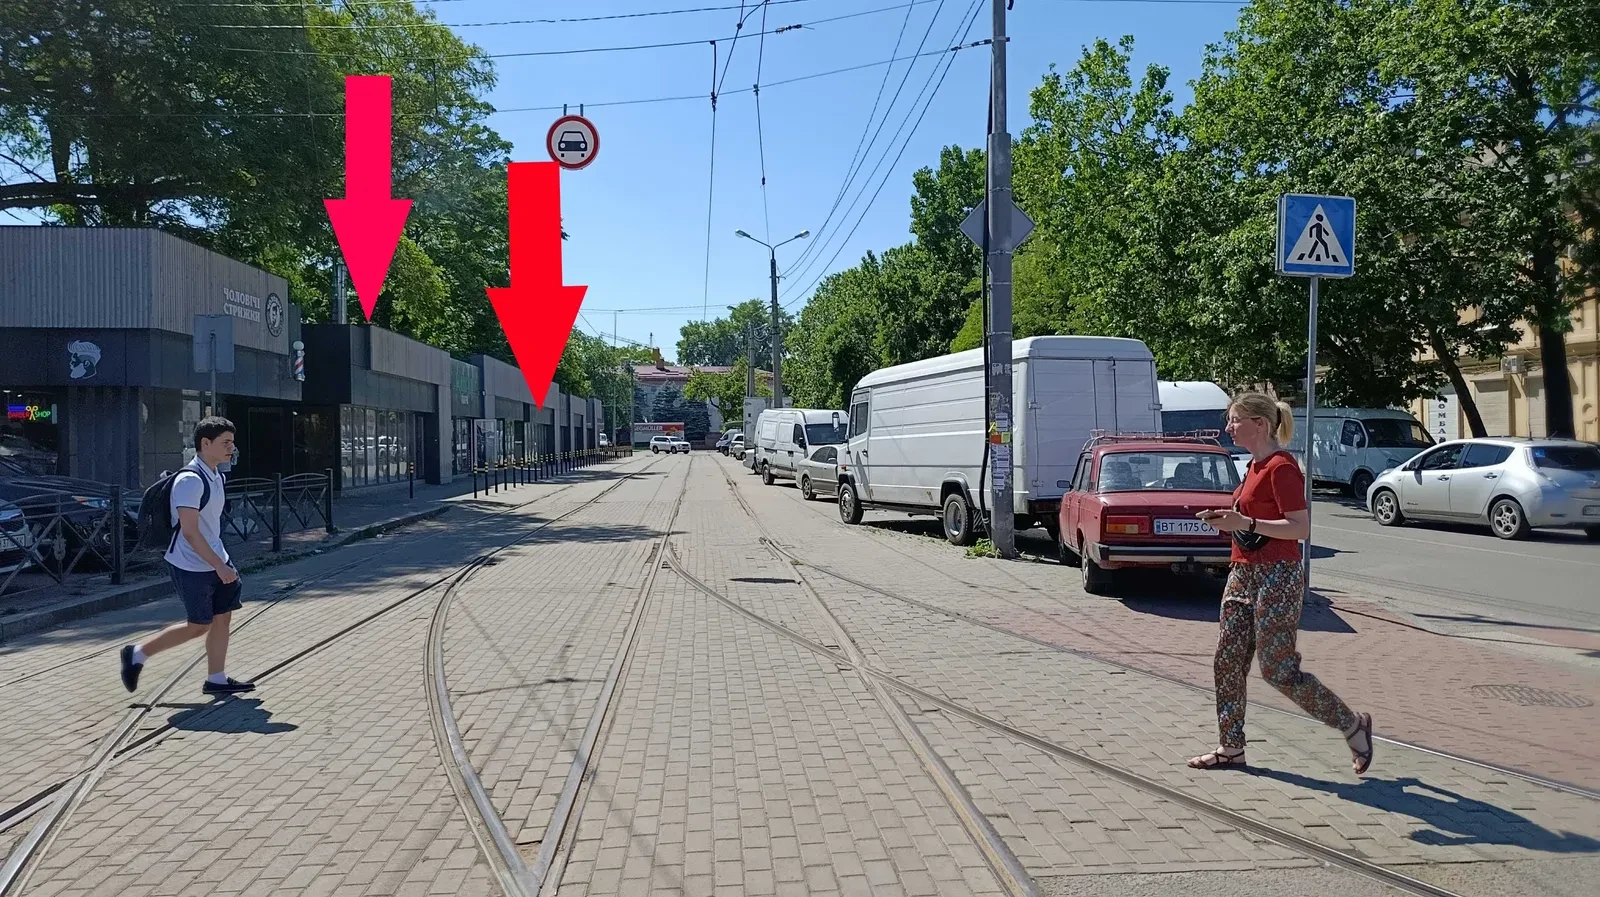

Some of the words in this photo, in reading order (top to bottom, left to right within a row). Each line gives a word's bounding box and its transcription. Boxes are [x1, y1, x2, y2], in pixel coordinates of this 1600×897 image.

[223, 287, 260, 308] ЧОЛОВІЧІ
[223, 302, 260, 323] СТРИЖКИ
[34, 410, 51, 418] SHOP
[1438, 396, 1447, 443] ОМБАР
[1161, 522, 1175, 532] BT
[1177, 522, 1200, 532] 1175
